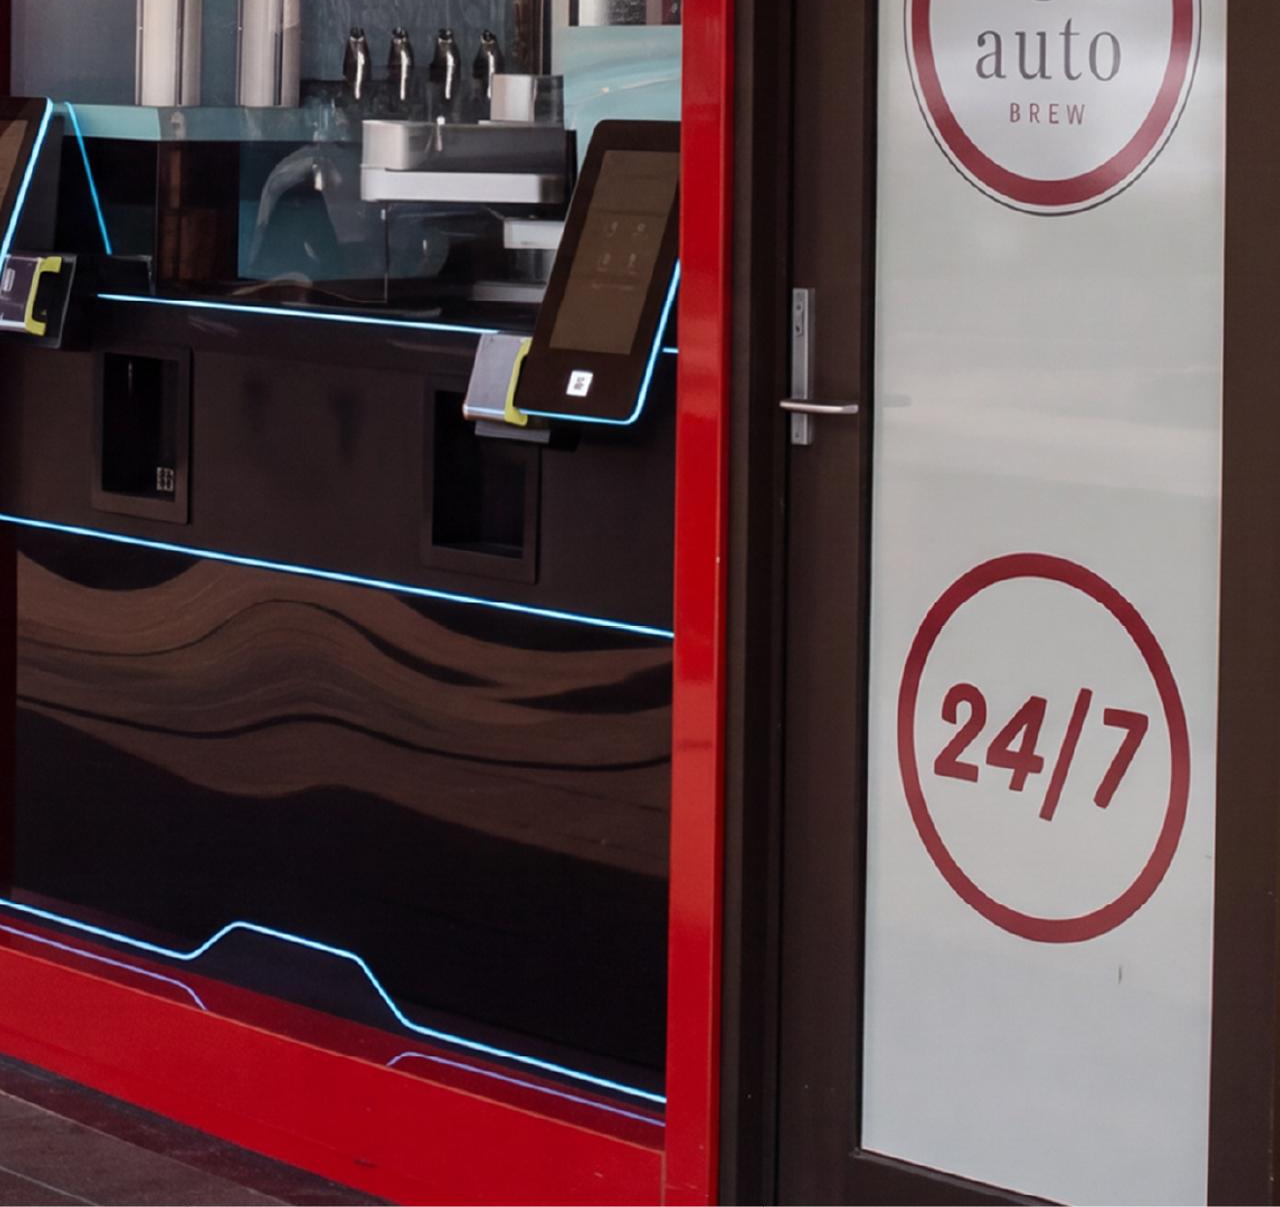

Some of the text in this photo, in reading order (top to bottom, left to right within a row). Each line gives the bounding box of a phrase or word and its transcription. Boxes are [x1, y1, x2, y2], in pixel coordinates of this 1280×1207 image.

[975, 18, 1121, 82] auto
[1009, 102, 1086, 125] BREW
[933, 682, 1150, 822] 24/7
